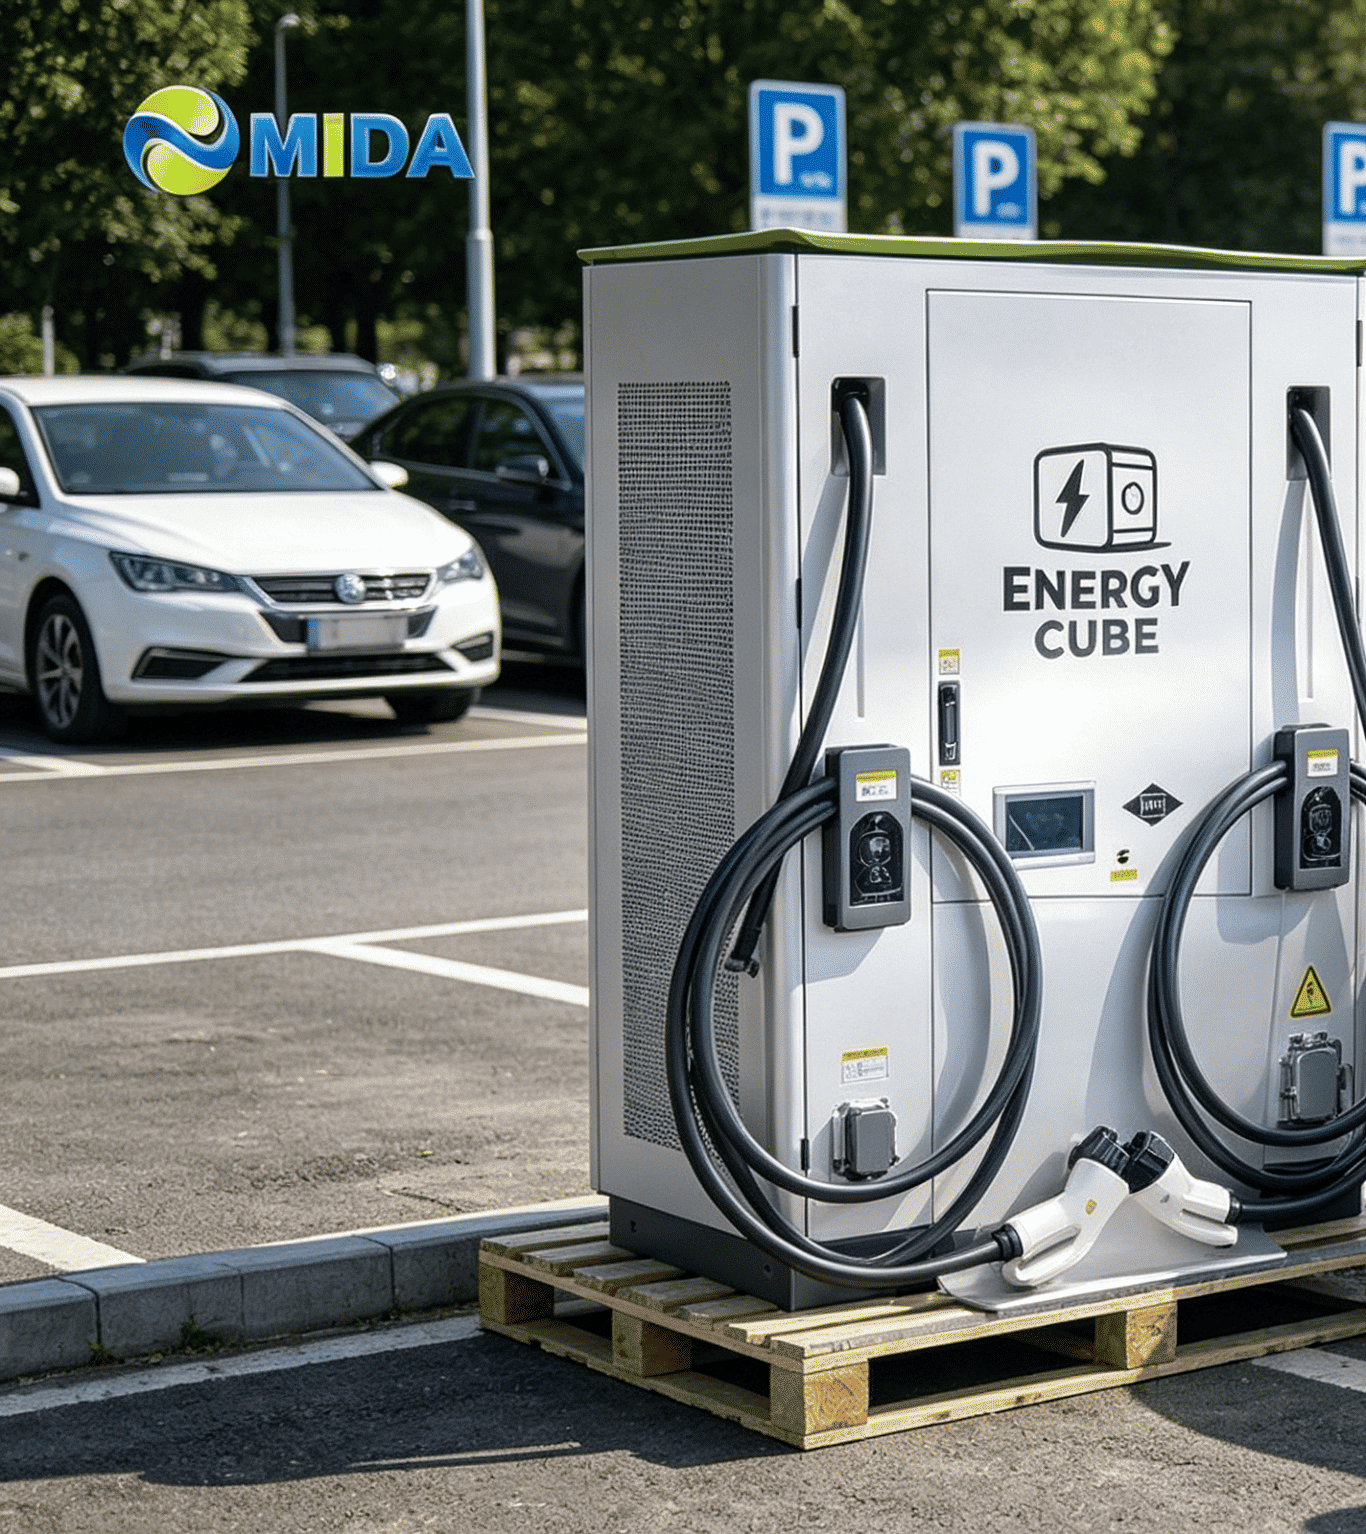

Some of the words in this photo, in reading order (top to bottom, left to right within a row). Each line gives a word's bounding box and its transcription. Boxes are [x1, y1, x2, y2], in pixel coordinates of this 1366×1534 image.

[773, 101, 824, 186] P
[972, 140, 1020, 217] P
[1003, 561, 1190, 612] ENERGY
[1034, 617, 1160, 659] CUBE
